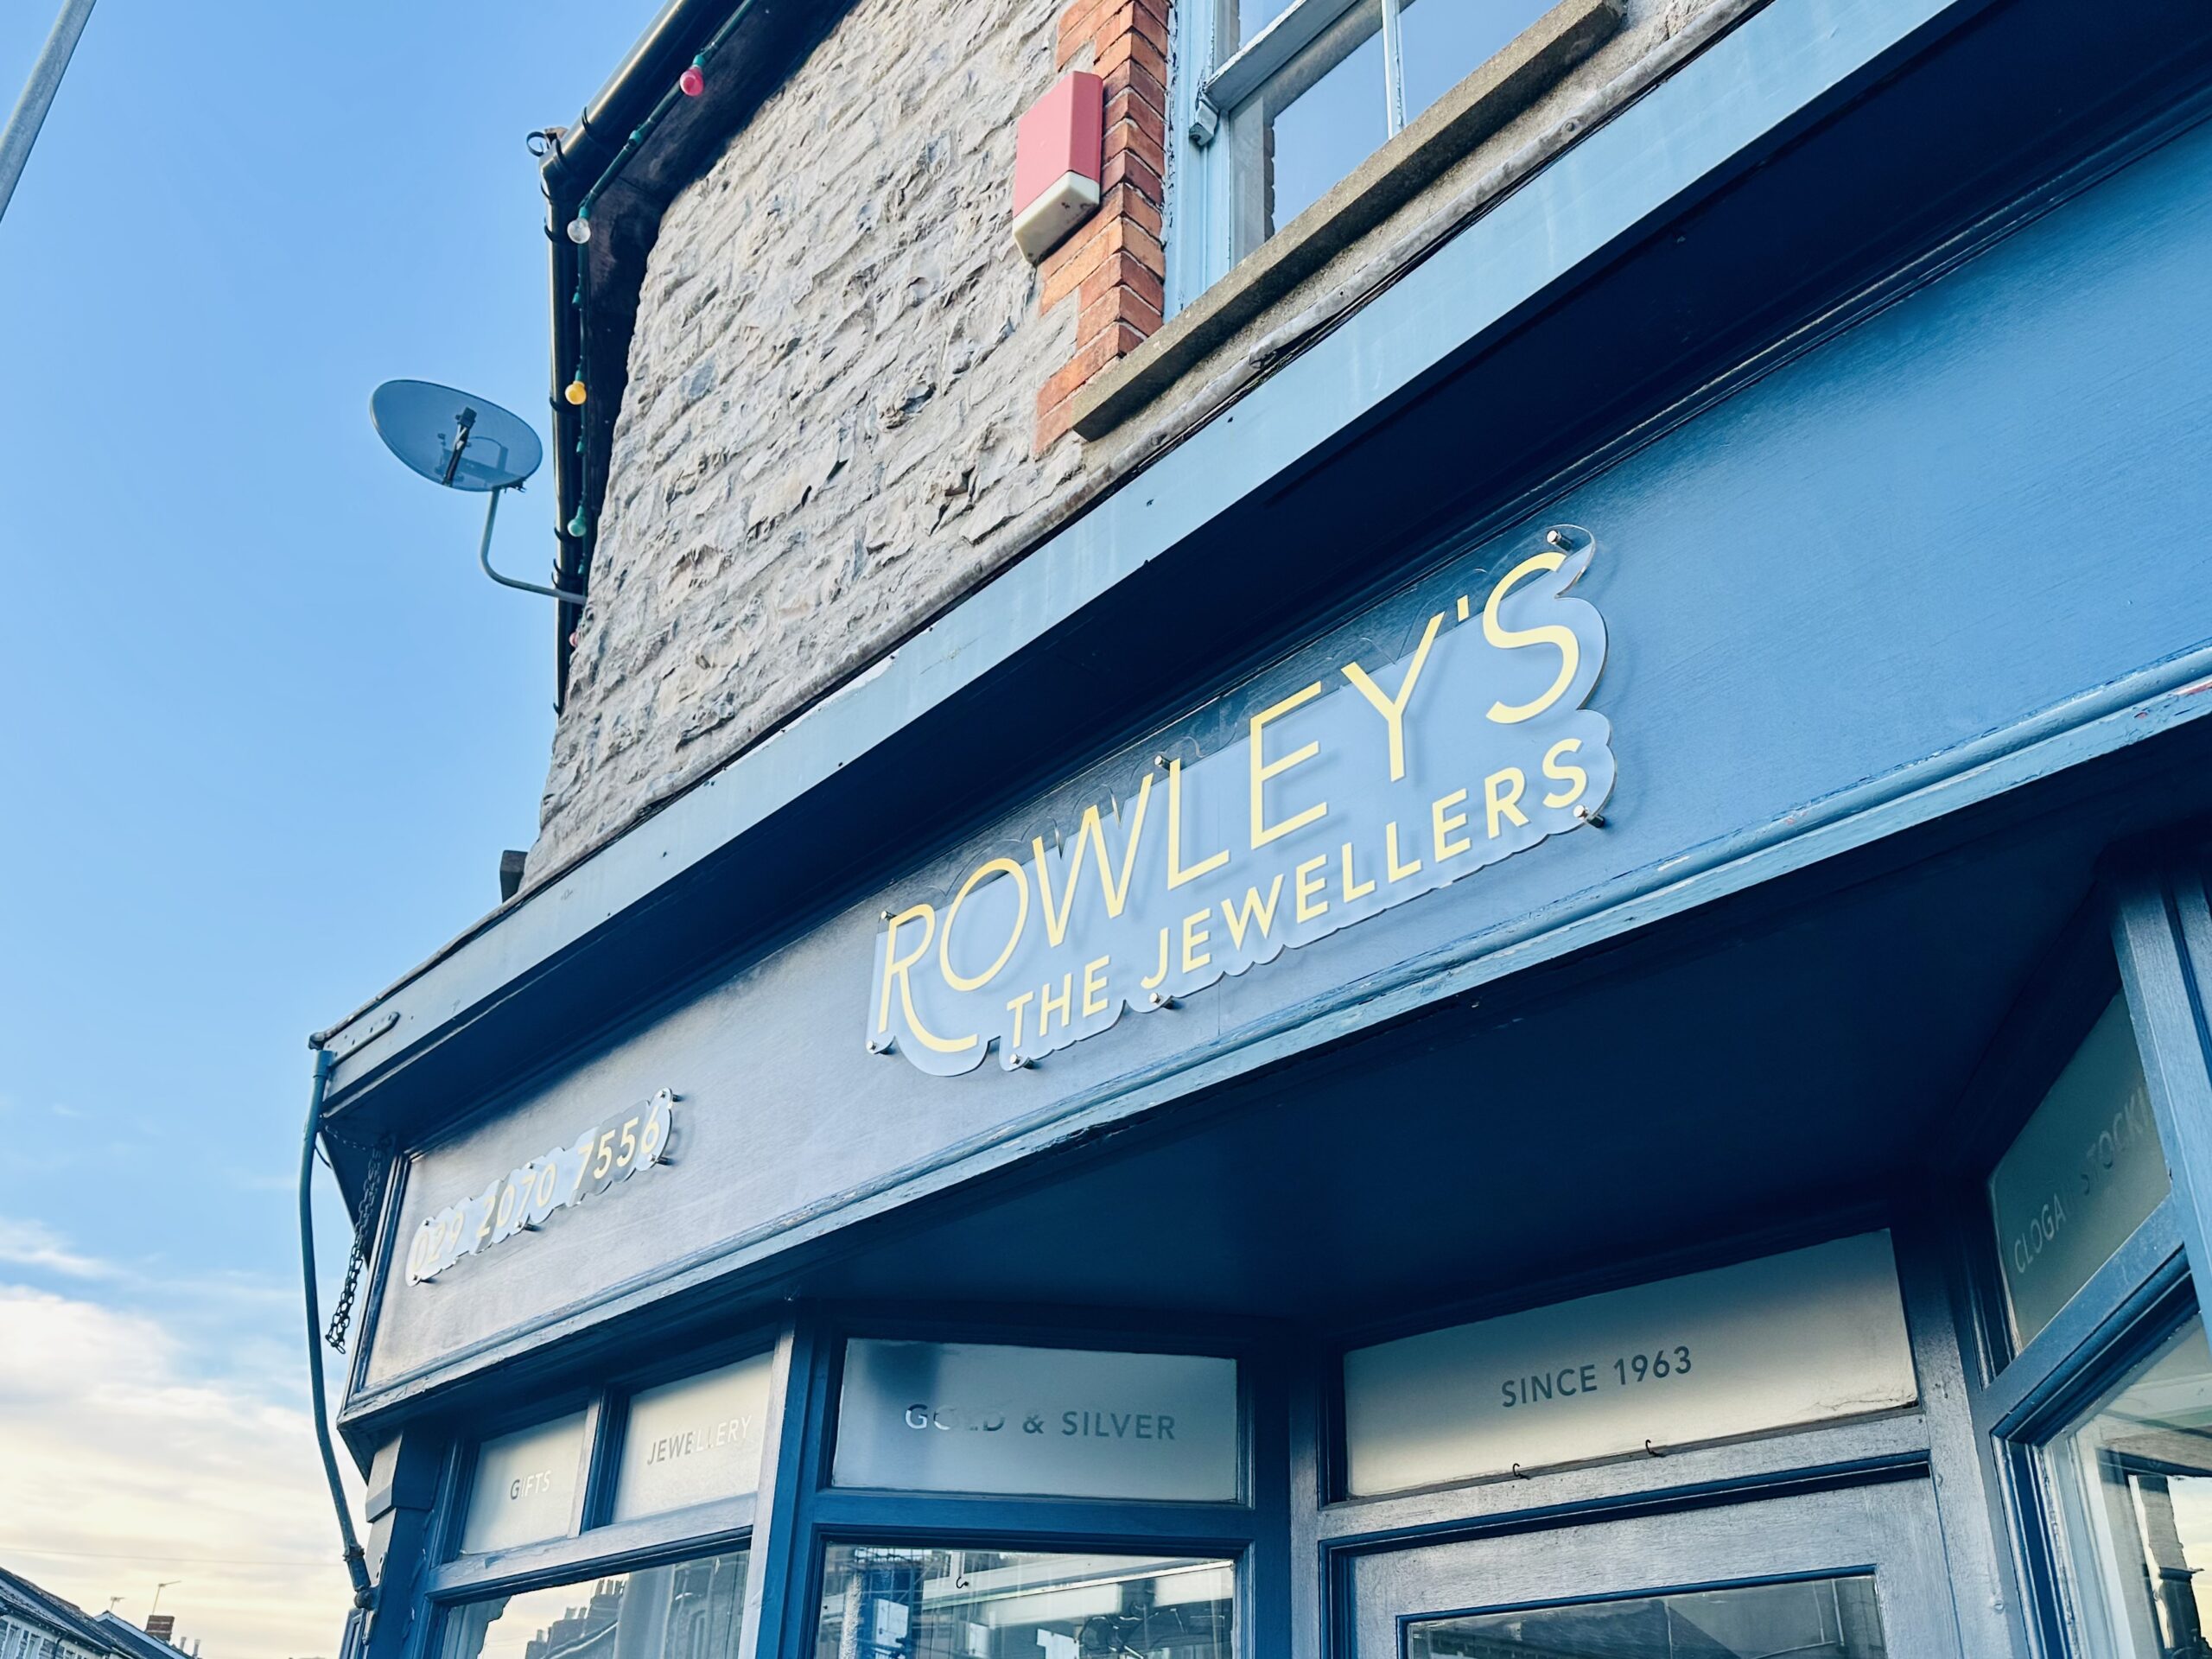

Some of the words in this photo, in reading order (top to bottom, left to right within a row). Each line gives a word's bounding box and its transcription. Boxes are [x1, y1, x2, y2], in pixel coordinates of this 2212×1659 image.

[878, 551, 1580, 1053] ROWLEY'S
[1006, 954, 1110, 1049] THE
[1140, 738, 1587, 990] JEWELLERS
[412, 1210, 465, 1273] 029
[476, 1162, 558, 1238] 2070
[572, 1104, 661, 1192] 7556
[1022, 1408, 1045, 1434] &
[1061, 1409, 1176, 1440] SILVER
[1501, 1363, 1599, 1408] SINCE
[1611, 1344, 1693, 1387] 1963
[510, 1470, 552, 1501] GIFTS
